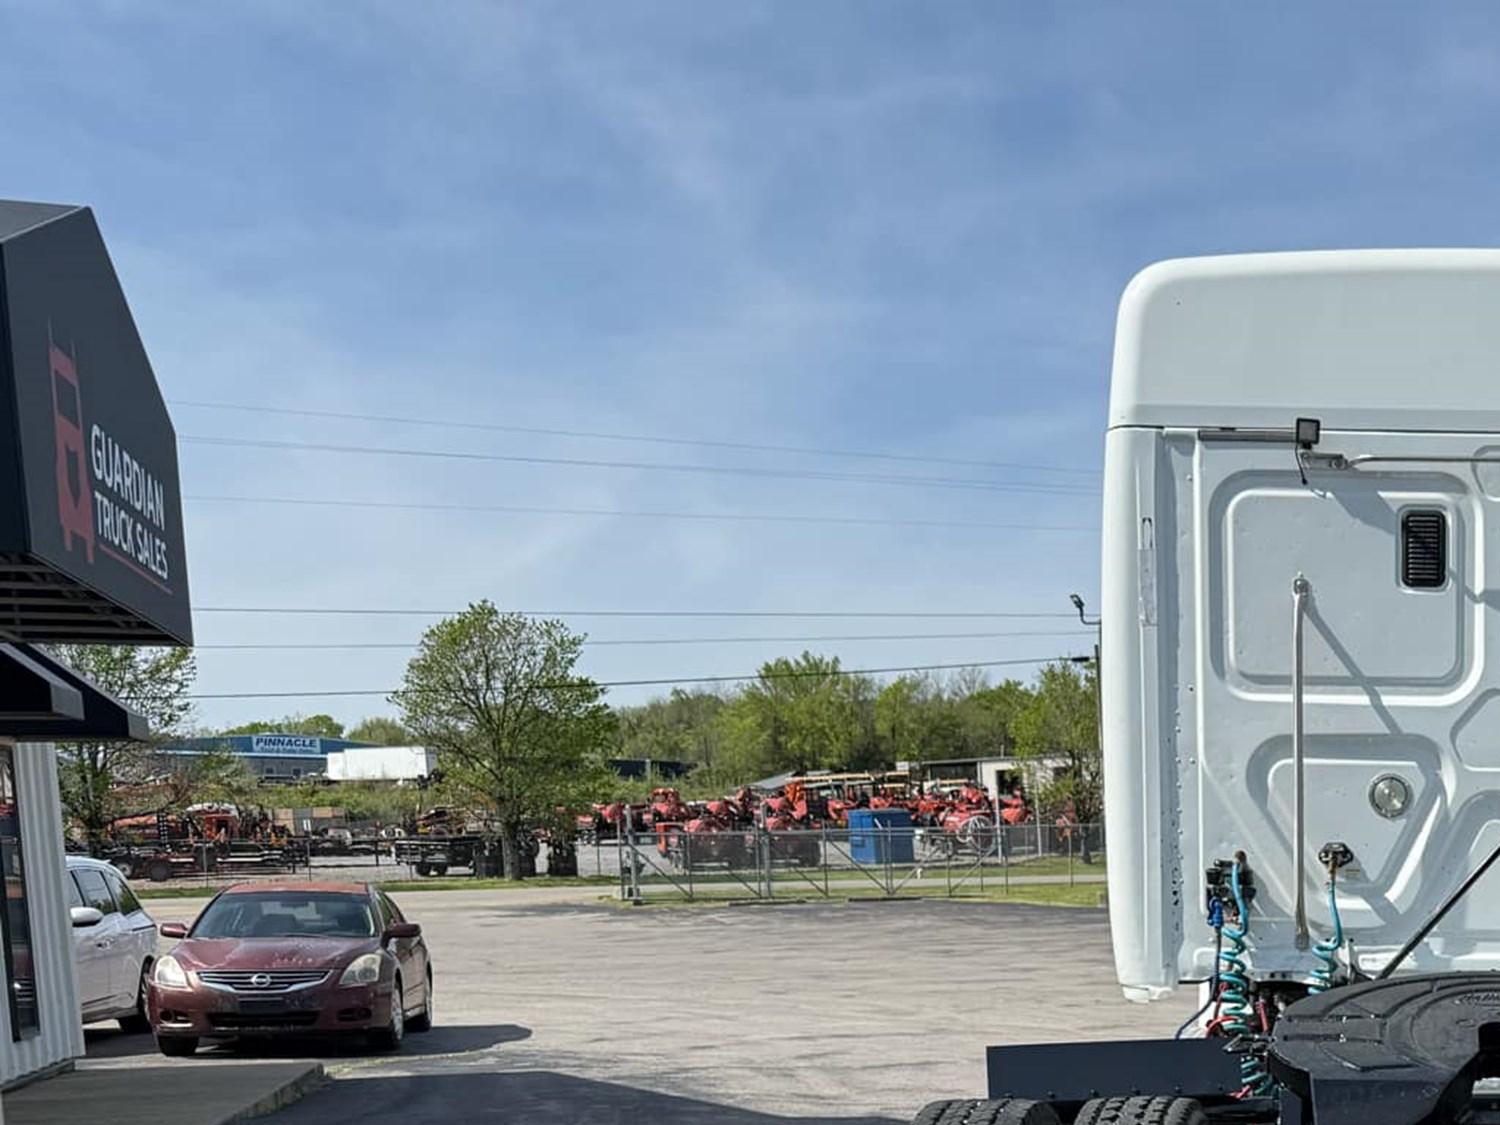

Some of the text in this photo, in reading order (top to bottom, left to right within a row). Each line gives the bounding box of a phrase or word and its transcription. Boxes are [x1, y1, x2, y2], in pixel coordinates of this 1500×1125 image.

[91, 424, 165, 531] GUARDIAN
[94, 490, 168, 580] TRUCK SALES
[255, 738, 317, 748] PINNACLE
